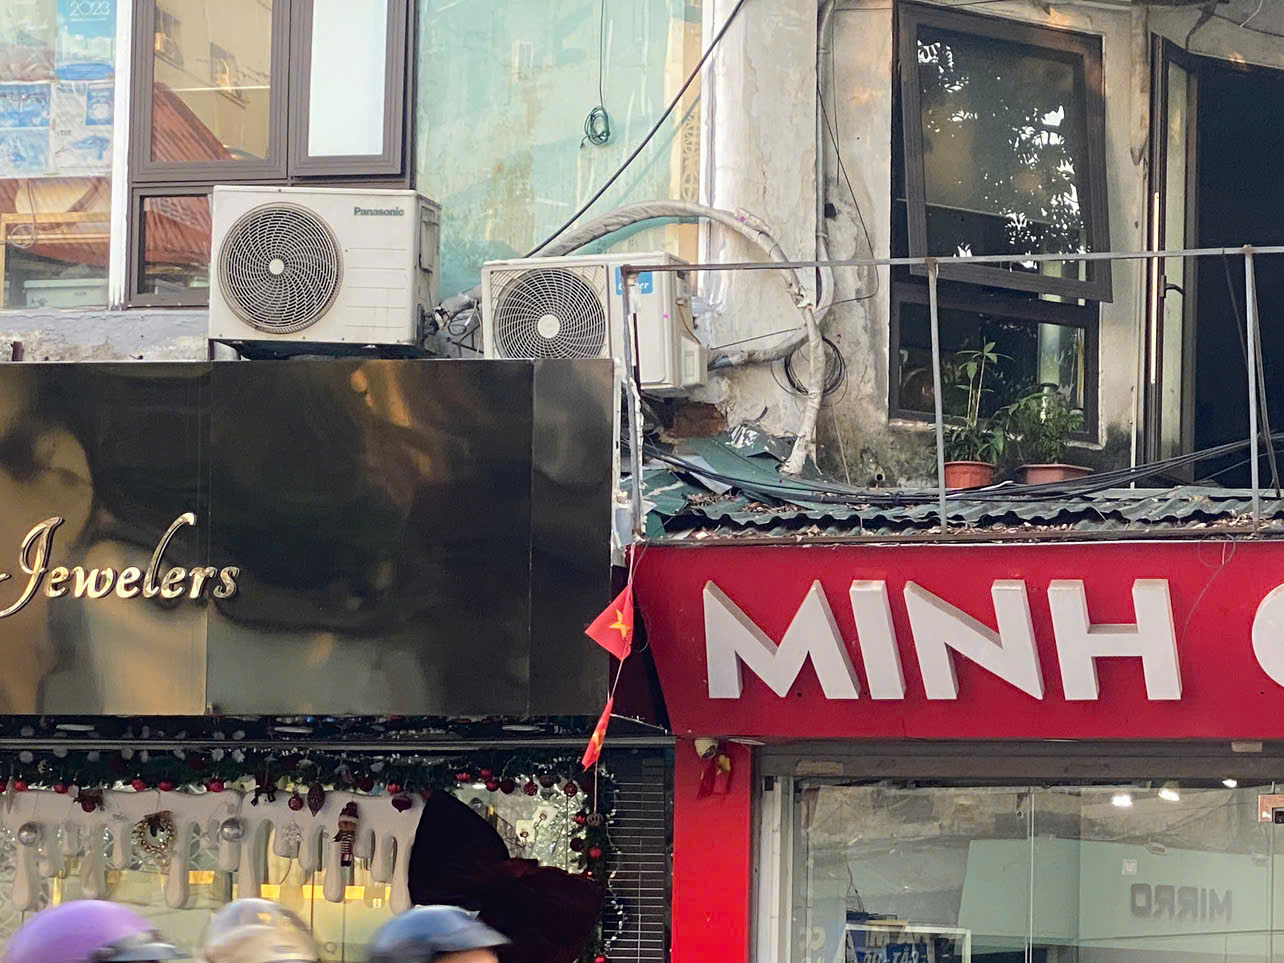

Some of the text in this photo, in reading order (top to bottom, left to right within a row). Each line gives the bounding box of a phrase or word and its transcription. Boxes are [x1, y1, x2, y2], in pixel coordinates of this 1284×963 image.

[353, 206, 405, 217] Panasonic
[0, 511, 241, 619] Jewelers
[702, 579, 1183, 700] MINH
